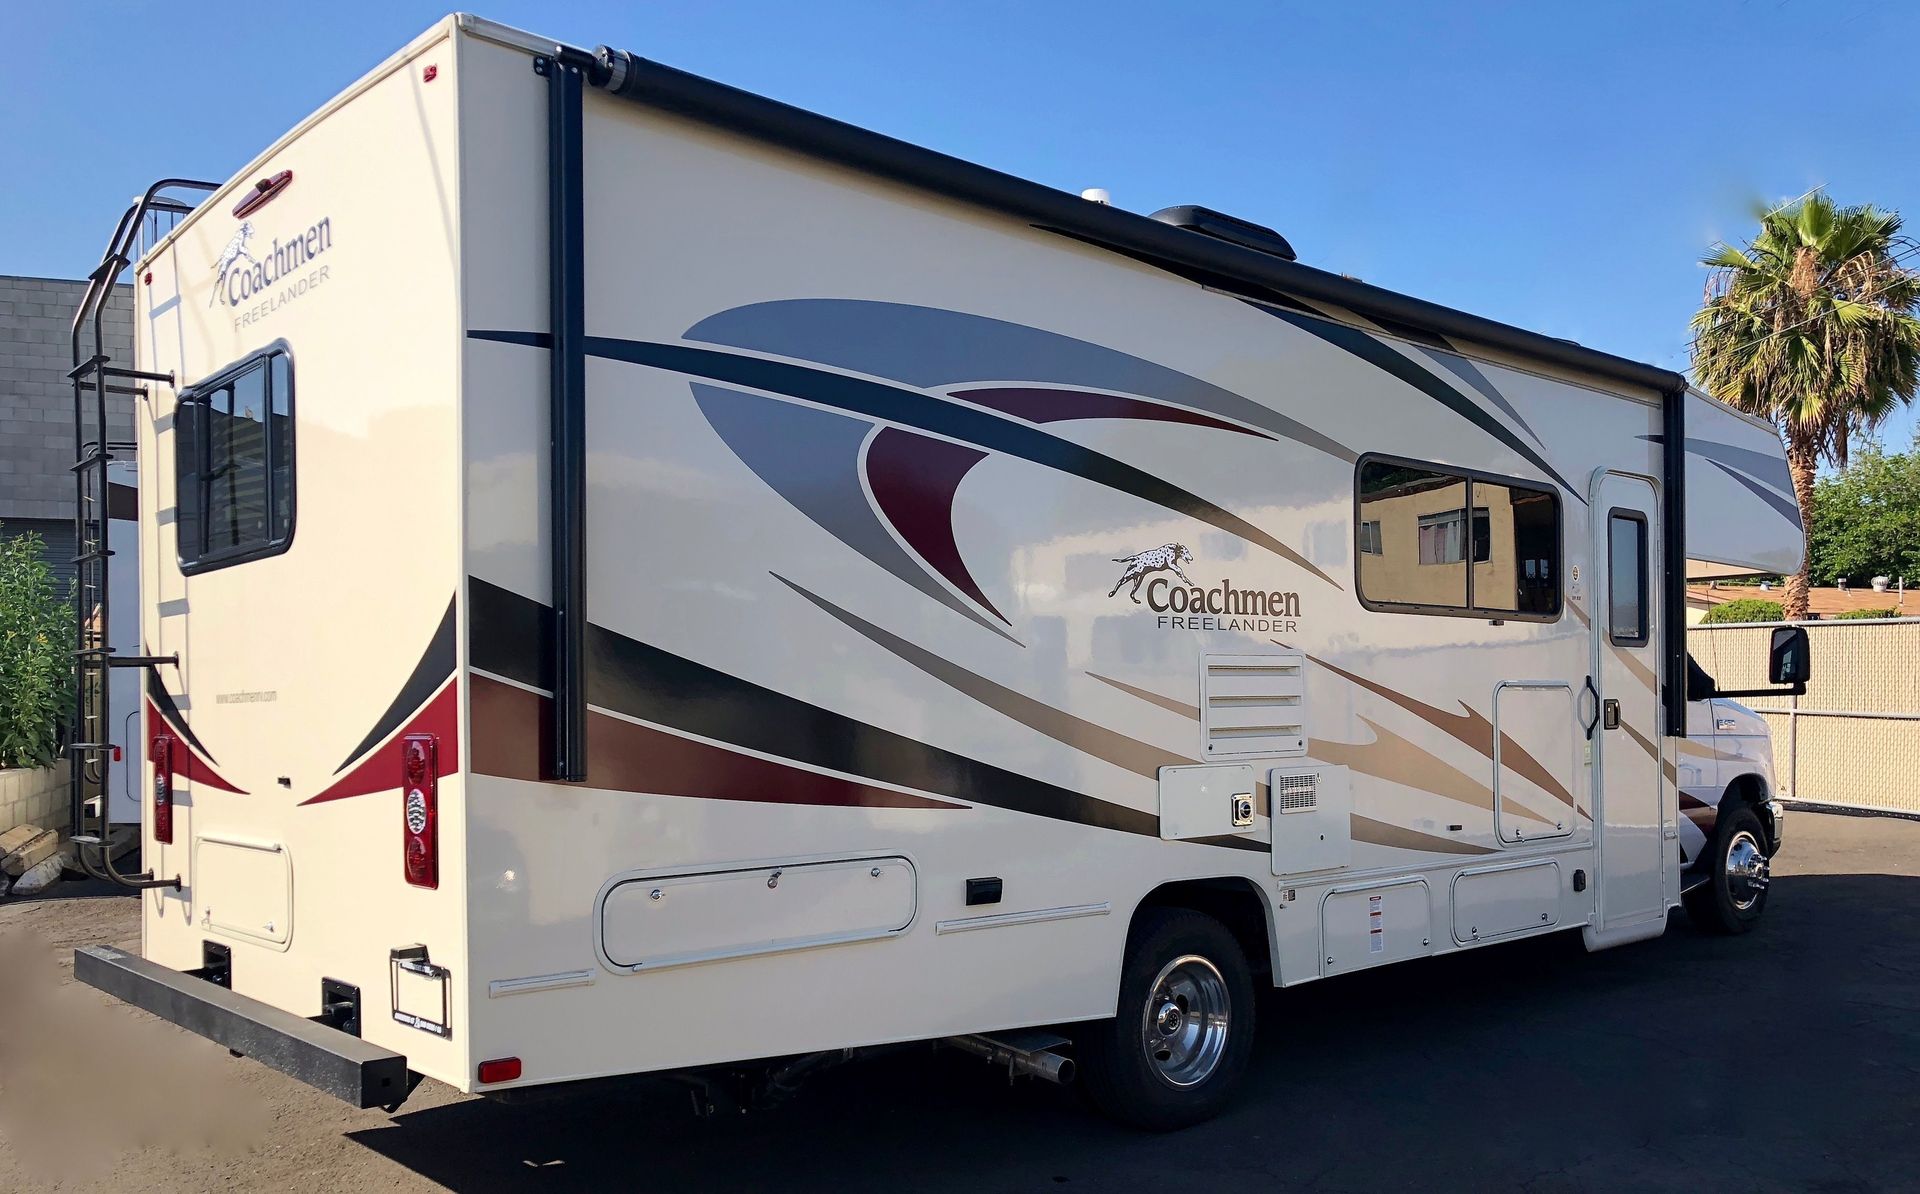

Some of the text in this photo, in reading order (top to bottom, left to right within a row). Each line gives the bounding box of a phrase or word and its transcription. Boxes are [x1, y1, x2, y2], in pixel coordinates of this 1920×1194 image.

[229, 216, 332, 307] Coachmen
[235, 265, 330, 333] FREELANDER
[1147, 578, 1301, 617] Coachmen
[1157, 616, 1298, 633] FREELANDER
